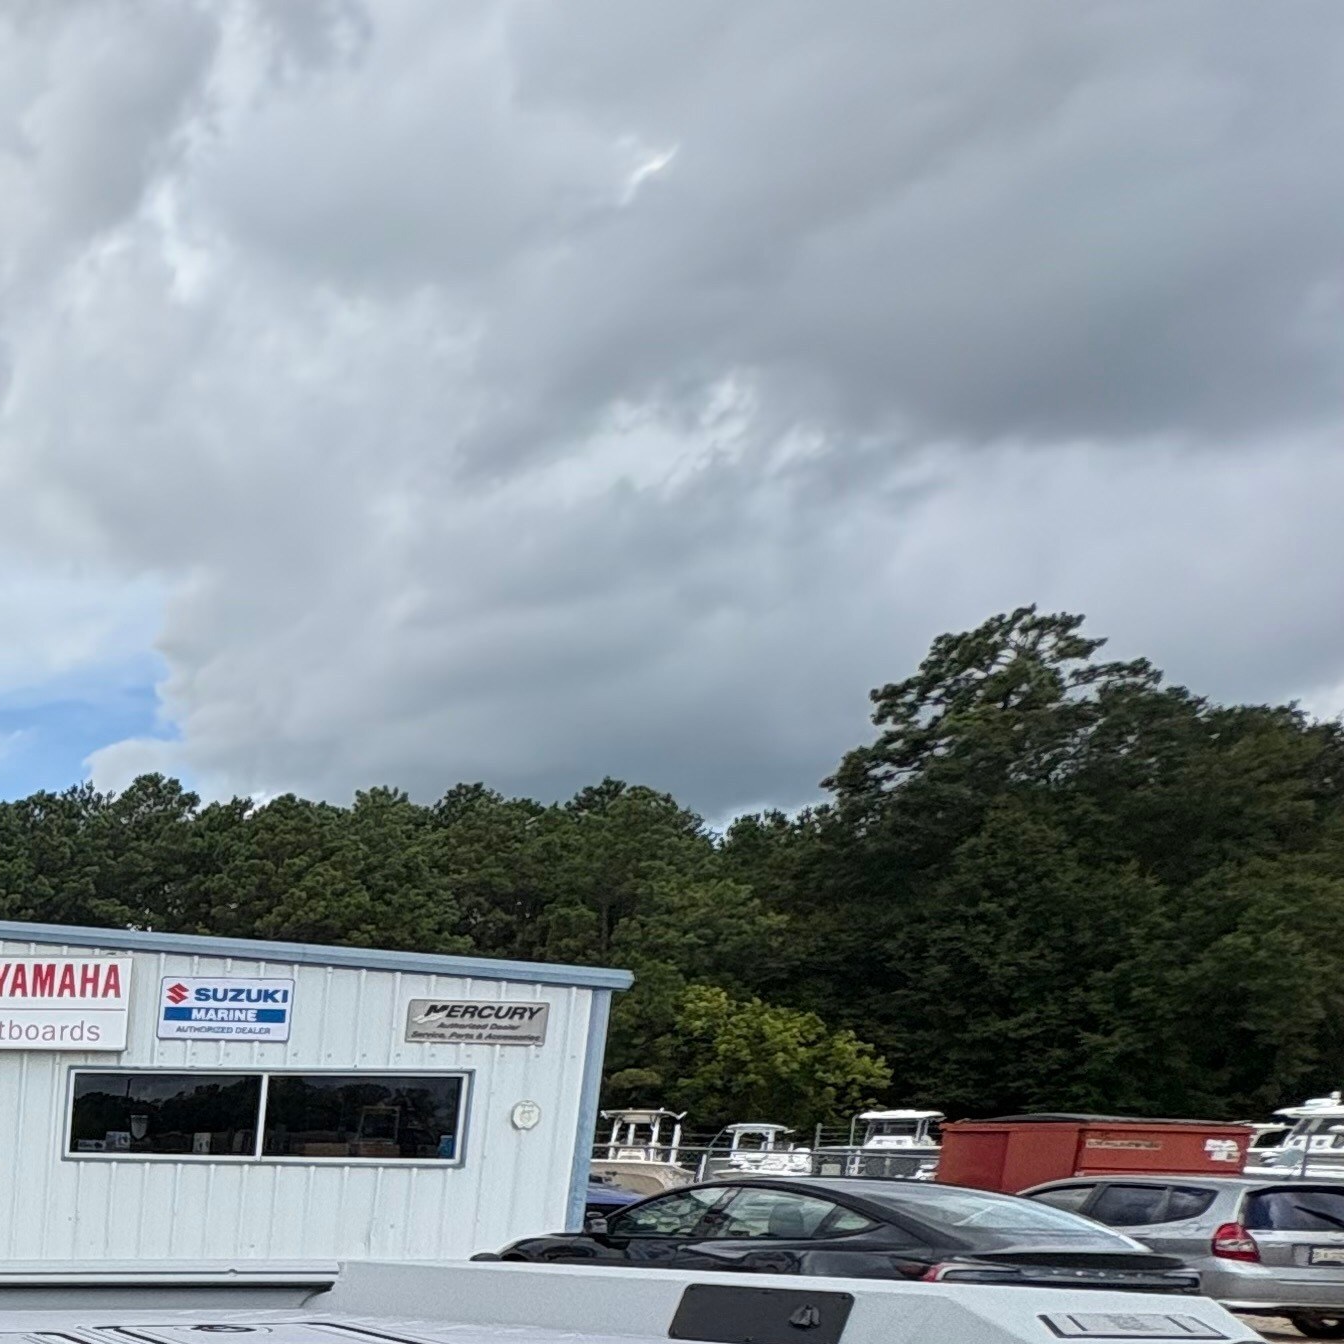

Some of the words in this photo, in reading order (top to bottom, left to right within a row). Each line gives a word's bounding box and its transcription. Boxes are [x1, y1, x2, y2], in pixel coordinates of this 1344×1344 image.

[194, 987, 289, 1003] SUZUKI
[191, 1008, 258, 1022] MARINE
[423, 1004, 544, 1020] MERCURY
[175, 1025, 233, 1034] AUTHORIZED
[235, 1026, 271, 1035] DEALER
